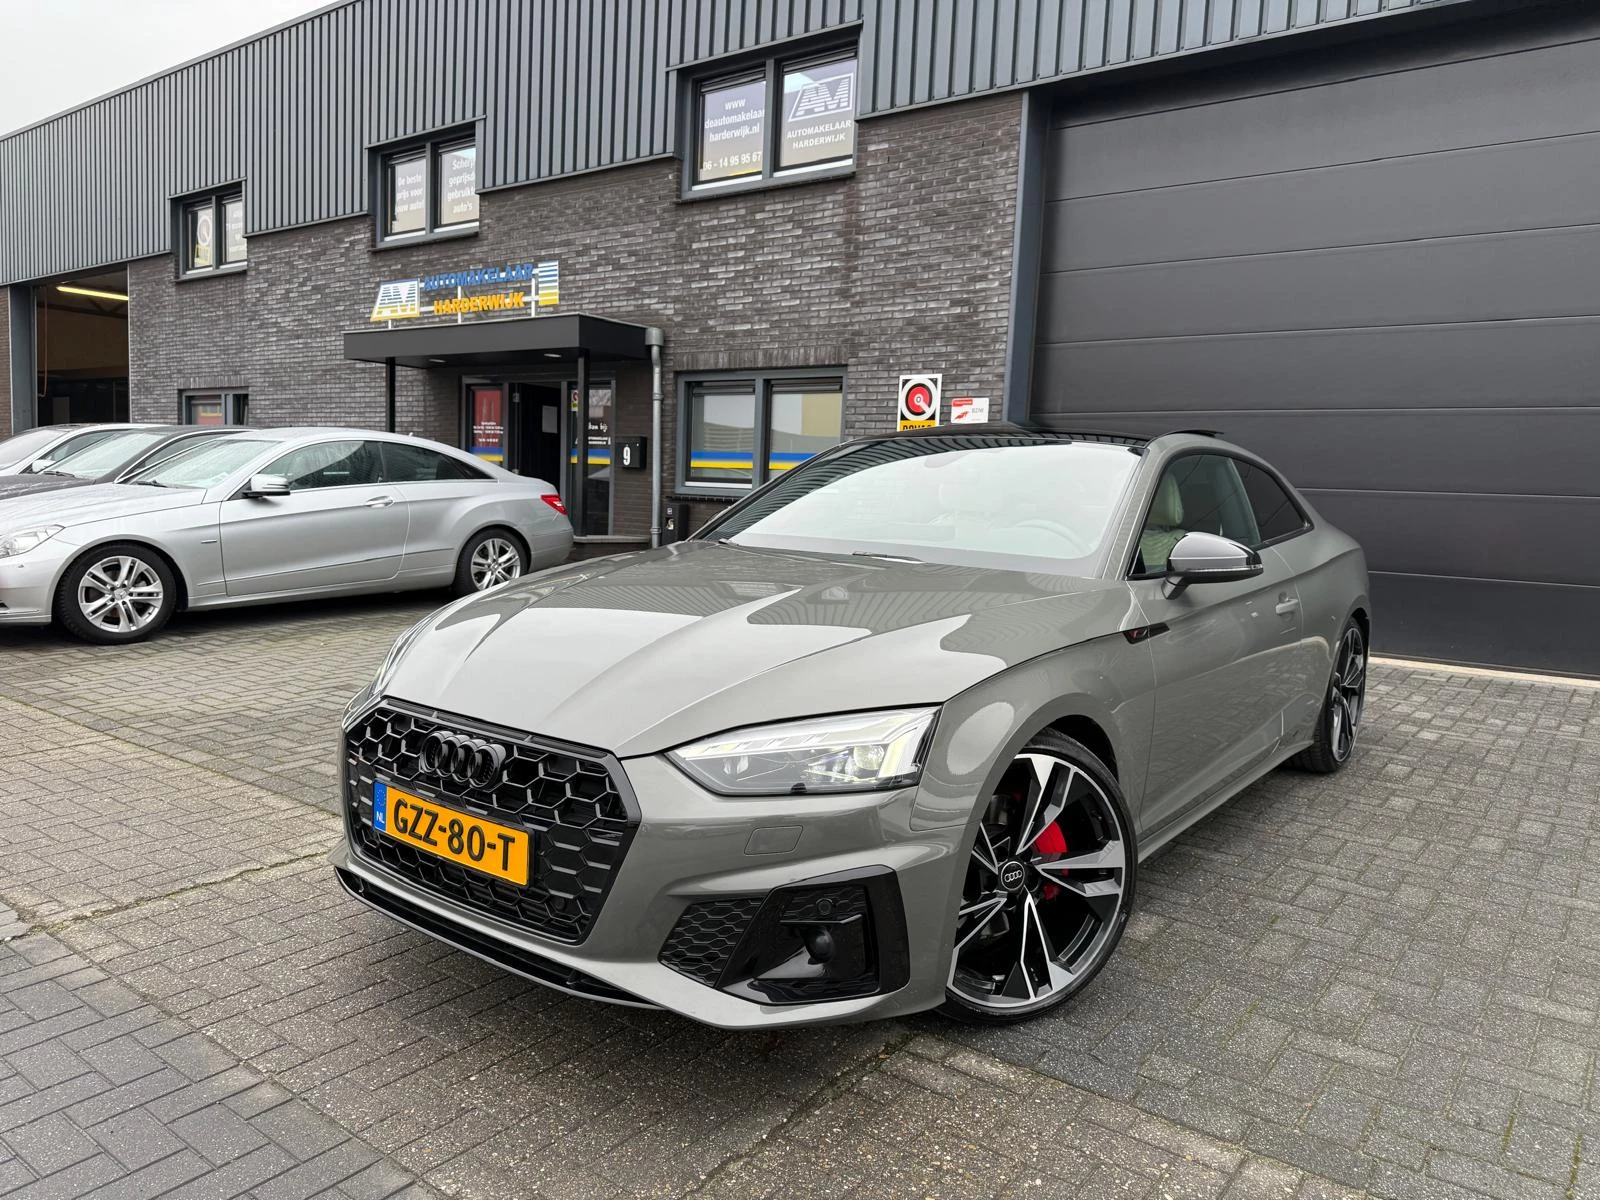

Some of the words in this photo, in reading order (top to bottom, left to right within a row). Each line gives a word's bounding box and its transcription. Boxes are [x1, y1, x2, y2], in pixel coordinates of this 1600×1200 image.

[724, 98, 746, 111] www
[709, 122, 760, 142] harderwijk.nl
[786, 119, 852, 140] AUTOMAKELAAR
[792, 132, 846, 150] HARDERWIJK
[719, 157, 728, 168] 14
[729, 154, 739, 166] 95
[740, 152, 751, 164] 95
[752, 151, 762, 163] 67
[423, 263, 534, 291] AUTOMAKELAAR
[433, 291, 526, 315] HARDERWIJK
[623, 446, 631, 466] 9
[376, 811, 385, 825] NL
[393, 798, 516, 872] GZZ-80-T
